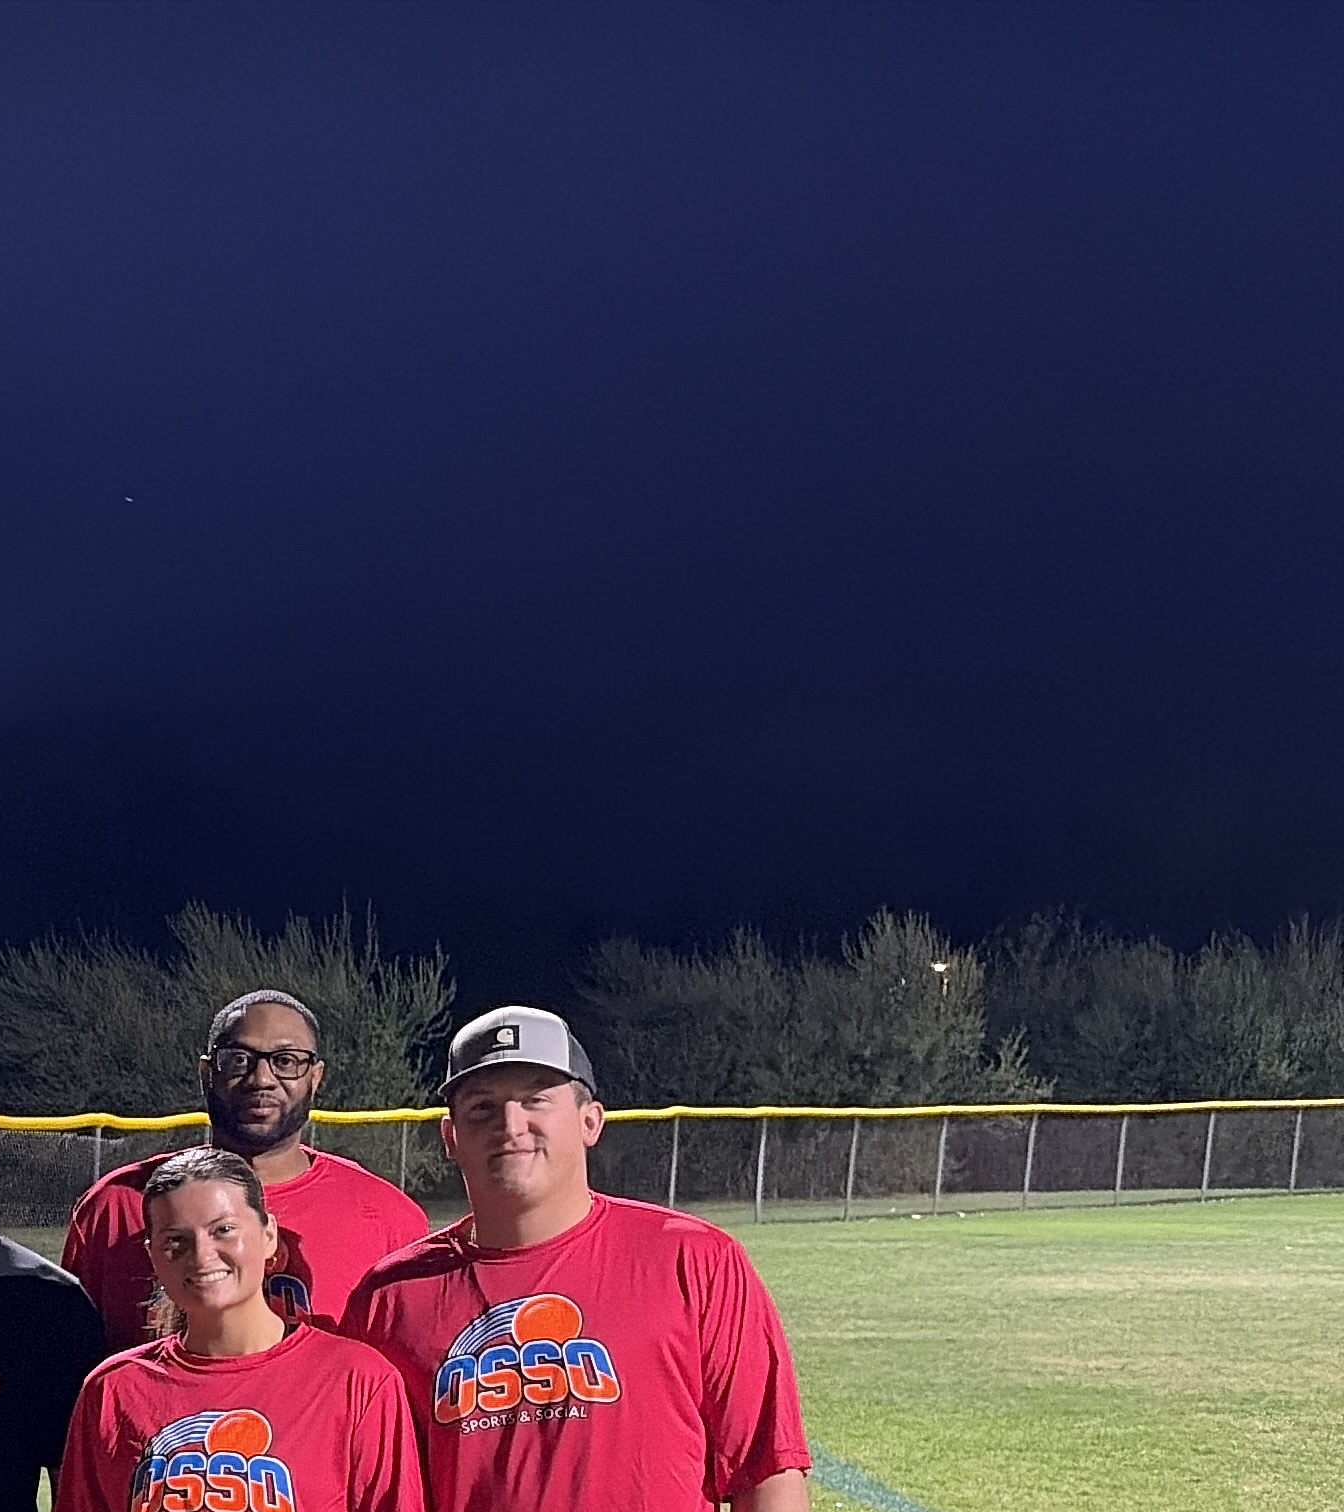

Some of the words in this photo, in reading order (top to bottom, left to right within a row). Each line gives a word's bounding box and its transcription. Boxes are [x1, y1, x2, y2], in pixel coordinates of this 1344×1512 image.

[434, 1339, 621, 1424] OSSO
[461, 1414, 516, 1434] SPORTS
[519, 1410, 531, 1423] &
[535, 1405, 588, 1421] SOCIAL
